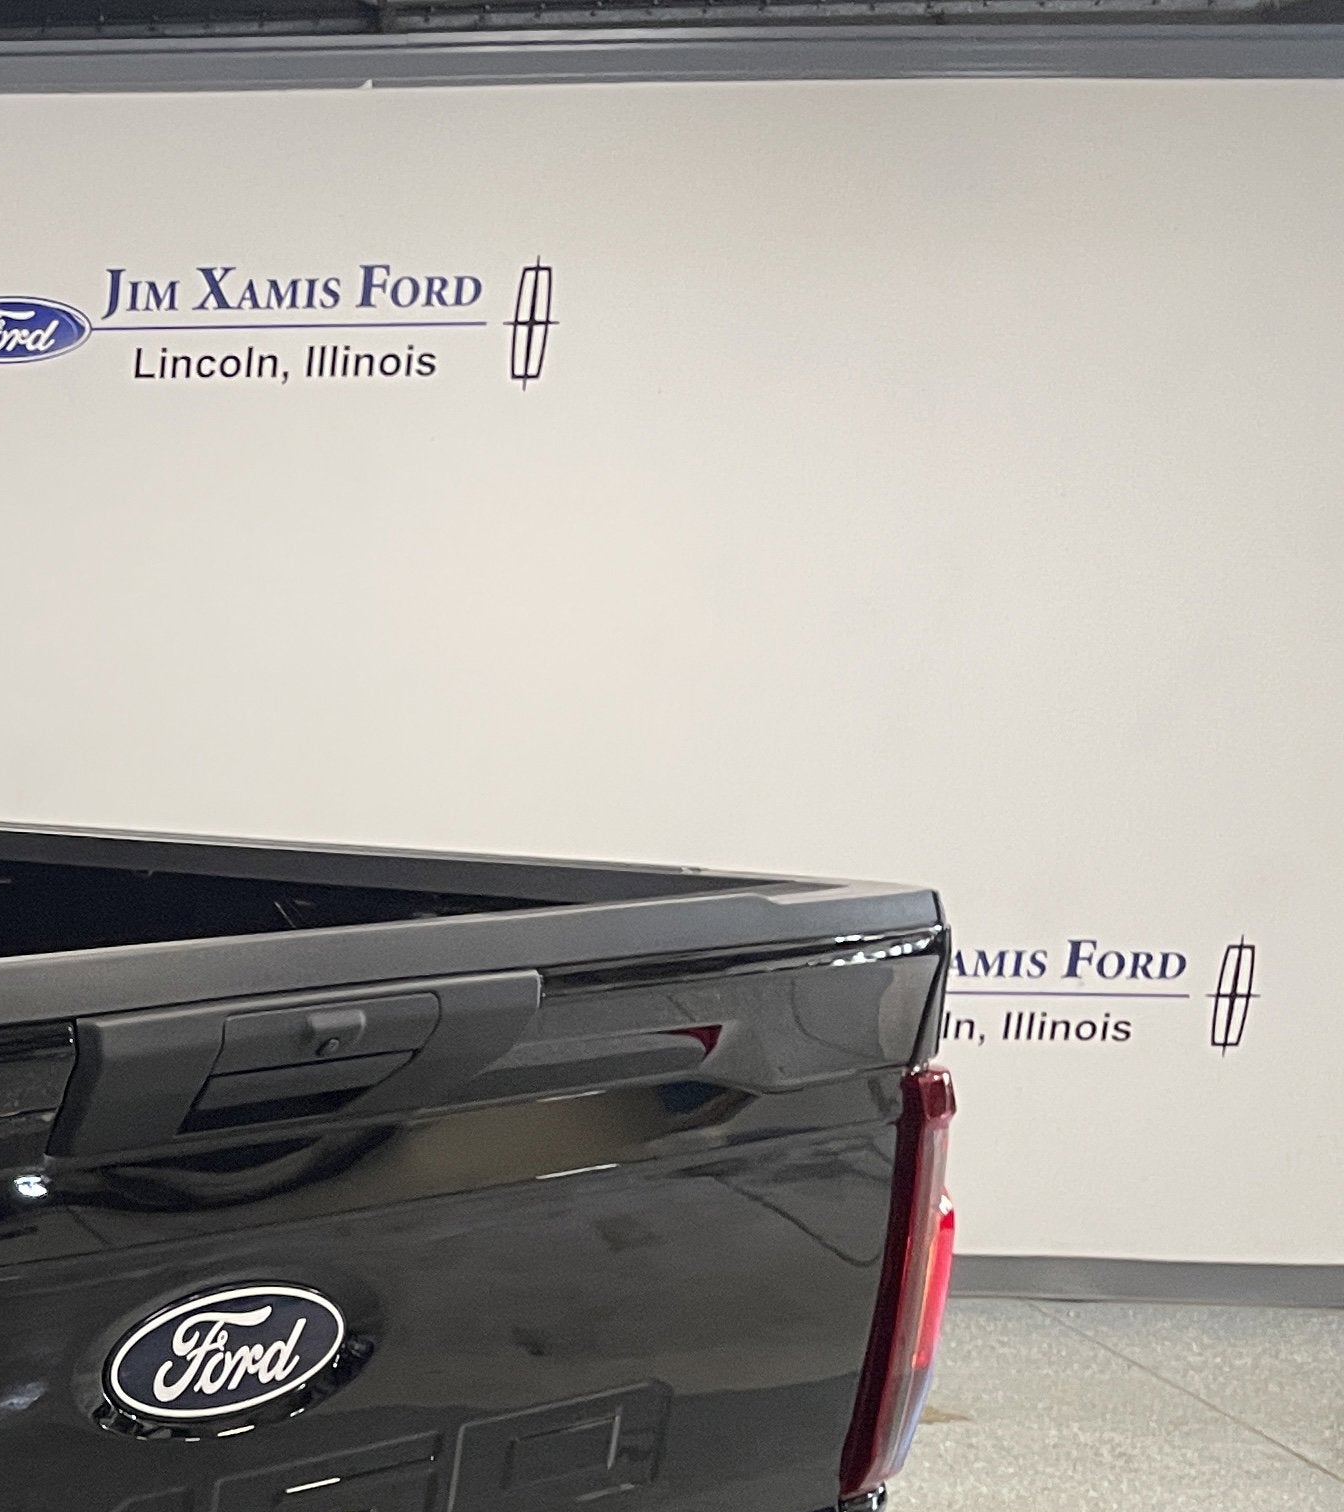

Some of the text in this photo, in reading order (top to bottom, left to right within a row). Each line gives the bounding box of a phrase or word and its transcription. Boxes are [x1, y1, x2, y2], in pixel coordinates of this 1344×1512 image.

[101, 264, 483, 320] JIM XAMIS FORD
[134, 344, 437, 385] Lincoln, Illinois
[950, 939, 1187, 980] AMIS FORD
[1002, 1010, 1132, 1042] Illinois
[153, 1306, 307, 1402] Ford
